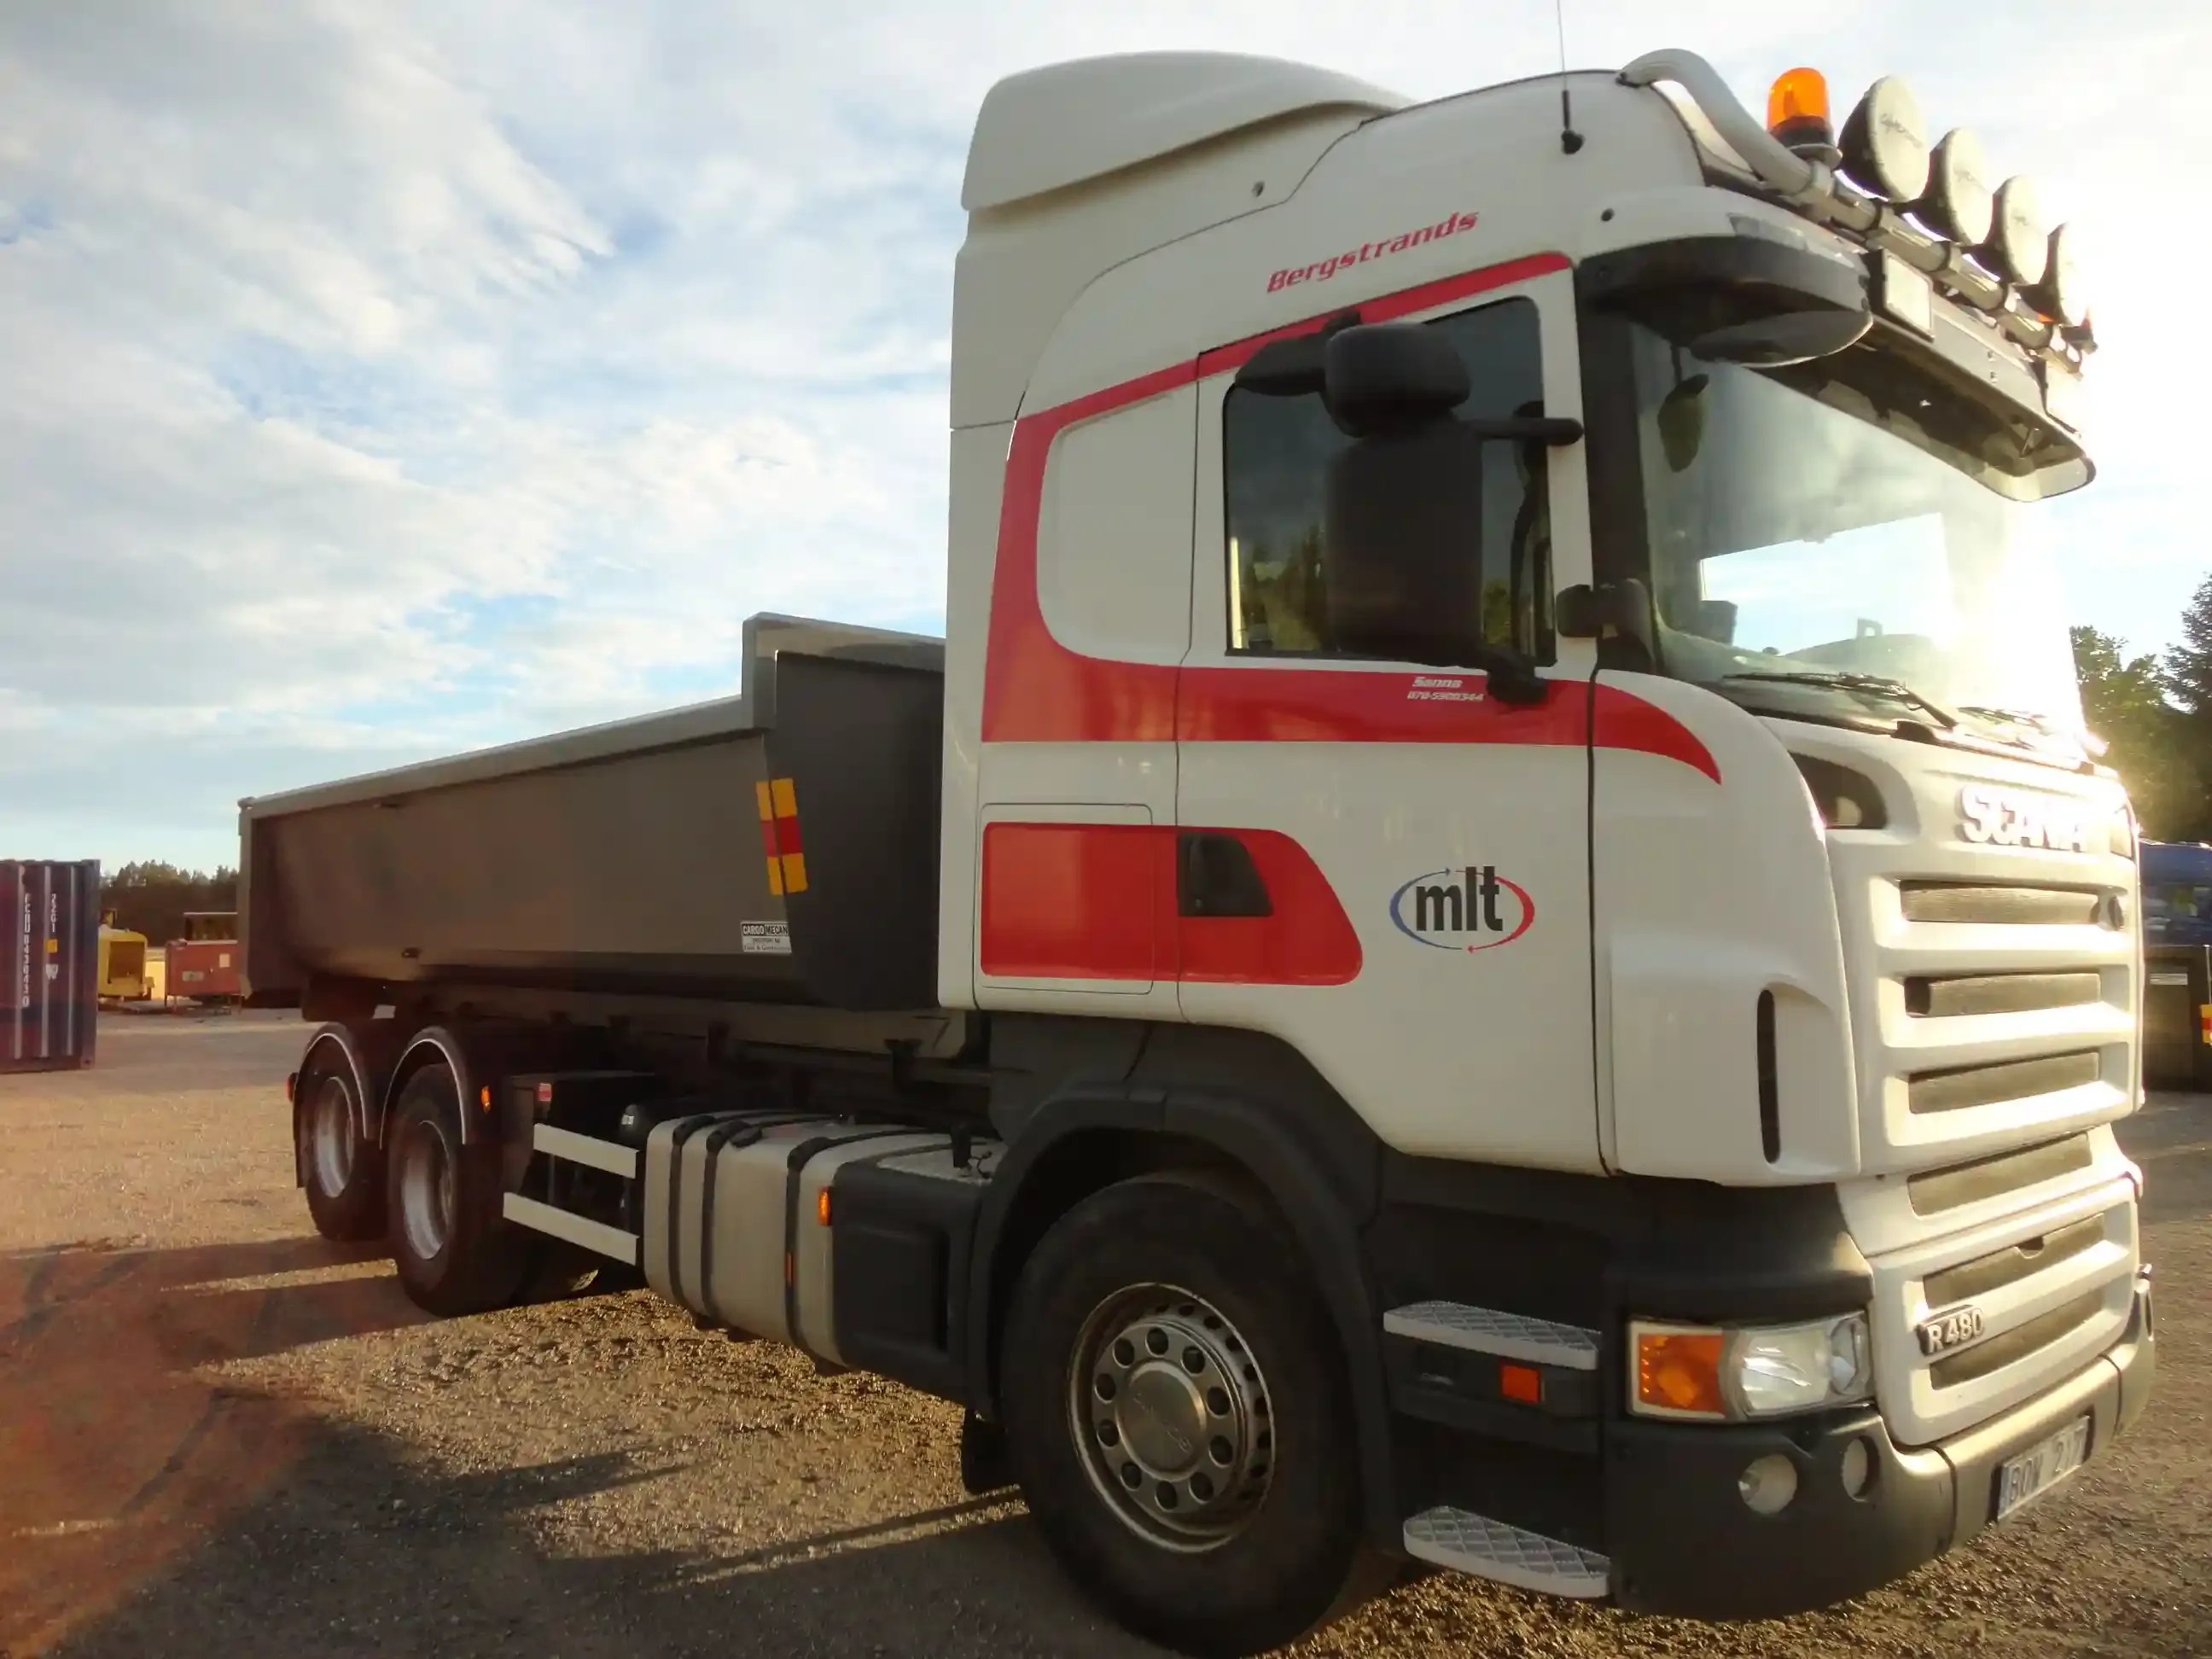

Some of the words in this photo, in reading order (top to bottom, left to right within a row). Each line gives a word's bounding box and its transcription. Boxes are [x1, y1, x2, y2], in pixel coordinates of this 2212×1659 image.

[1267, 212, 1480, 294] Bergstrands
[1416, 865, 1504, 932] mlt
[1928, 1324, 1945, 1354] R
[1945, 1307, 1984, 1345] 480
